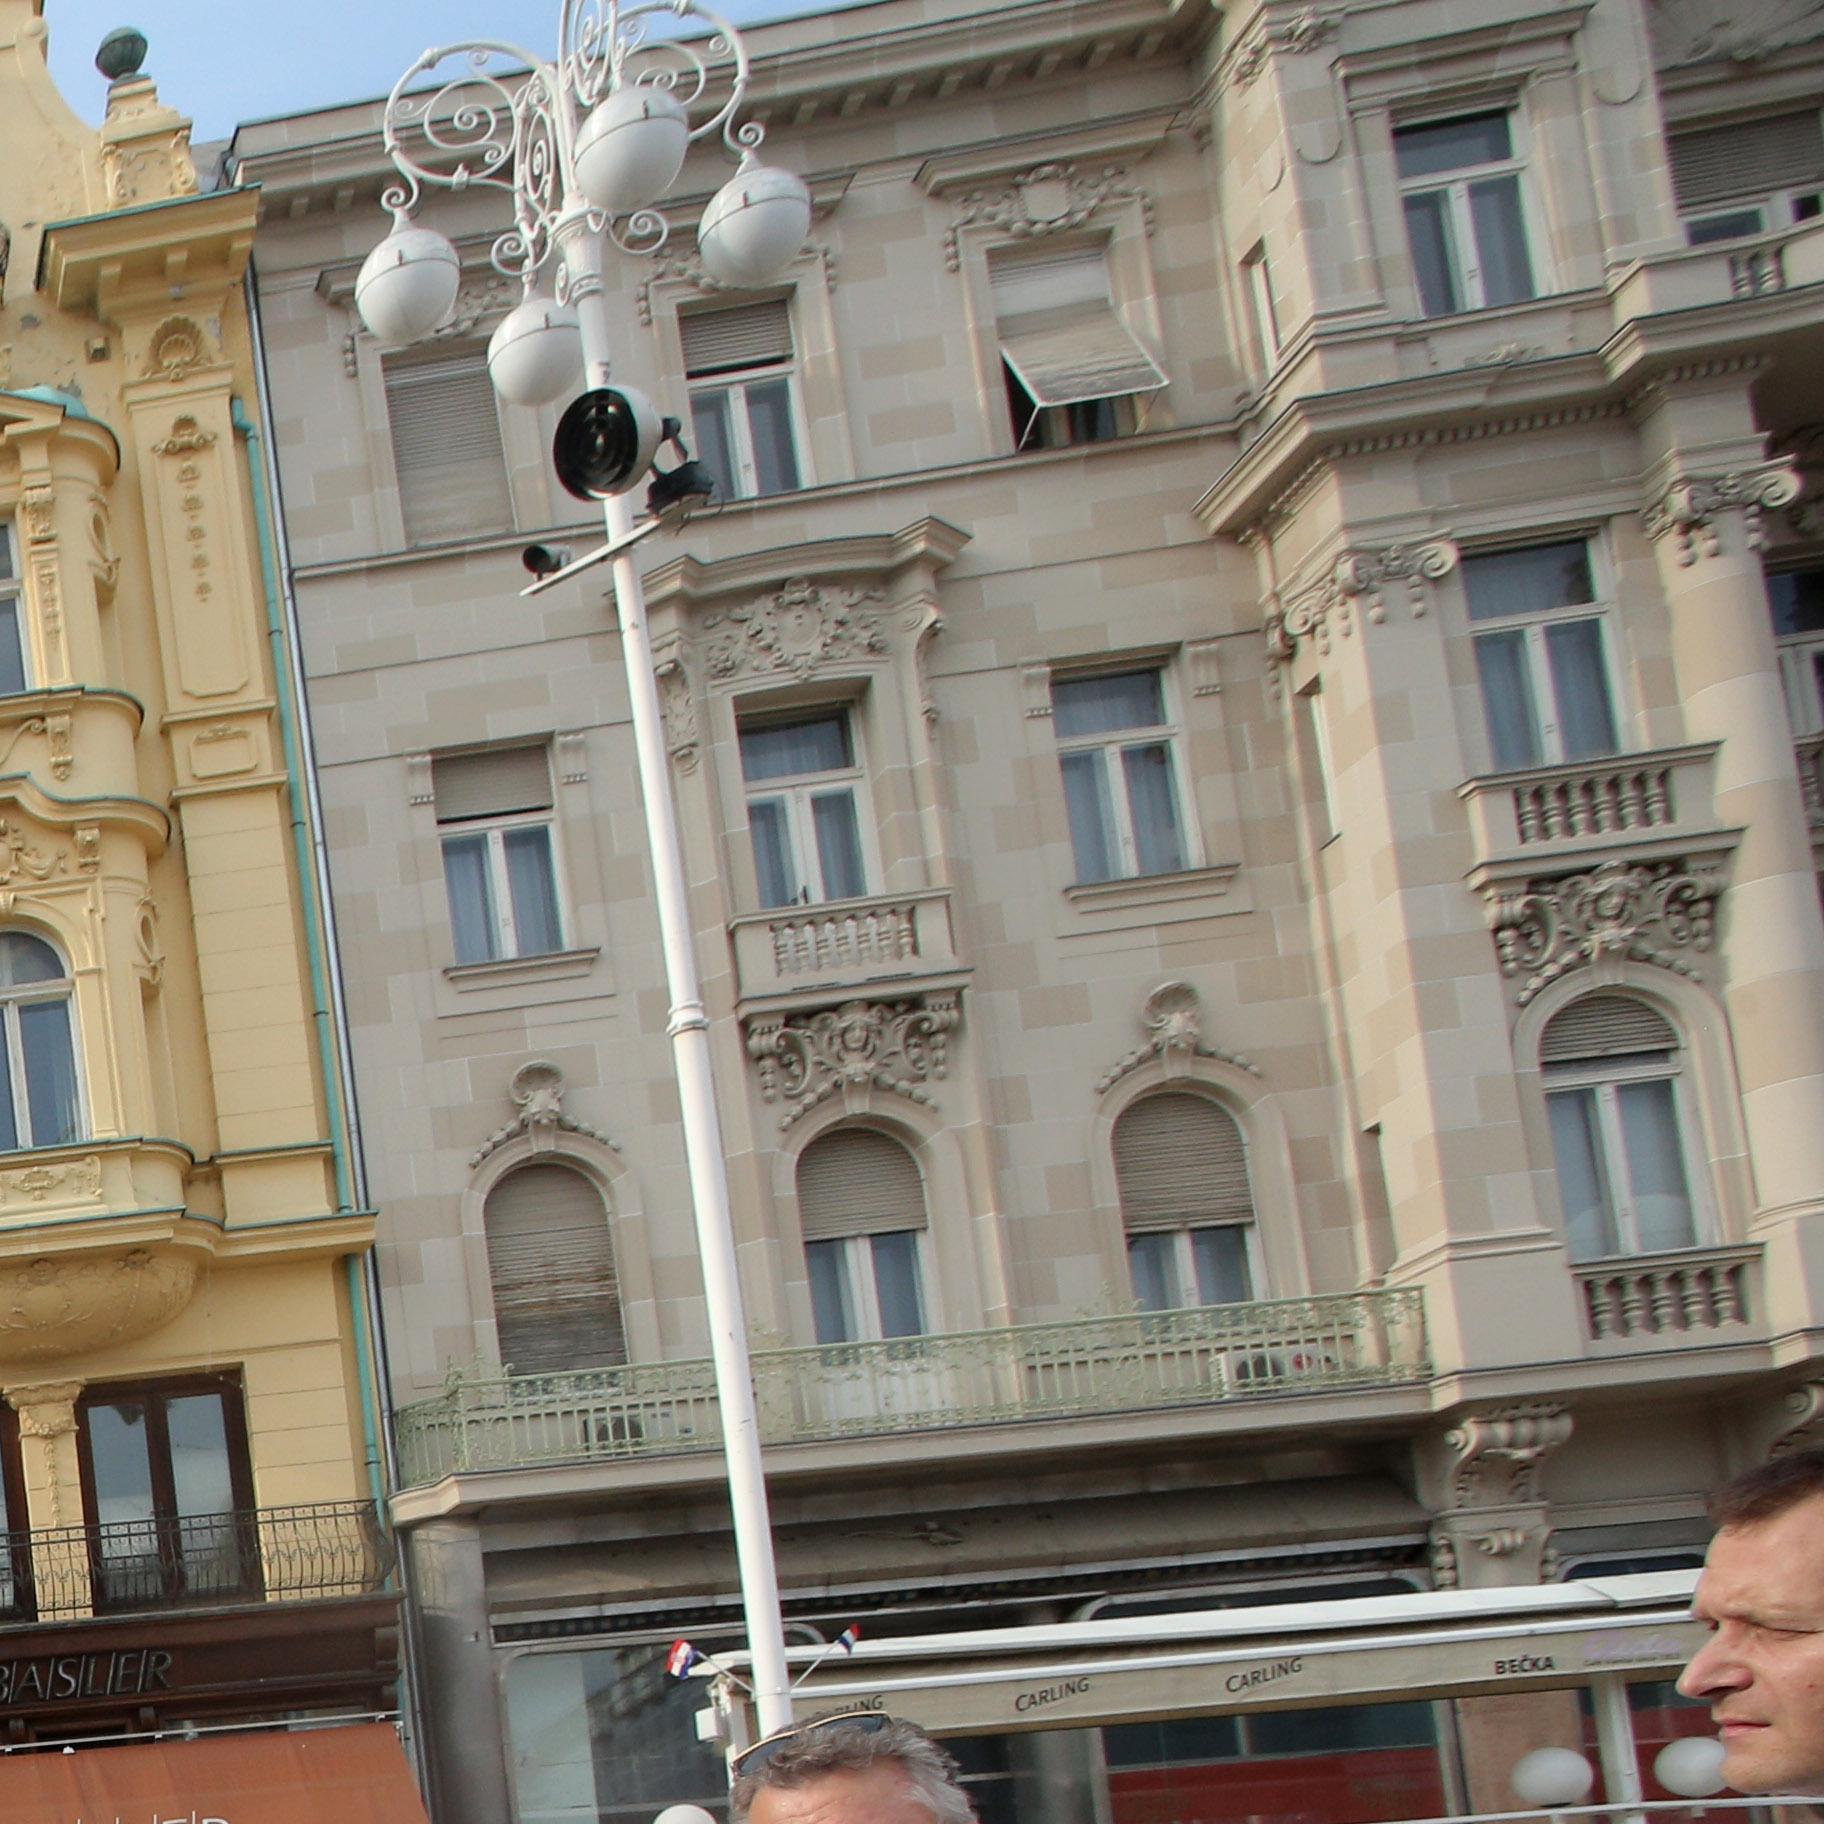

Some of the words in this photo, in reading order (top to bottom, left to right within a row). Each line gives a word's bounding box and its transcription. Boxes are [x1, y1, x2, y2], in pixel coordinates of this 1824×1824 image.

[1225, 1657, 1304, 1693] CARLING
[1495, 1654, 1555, 1676] BEČKA
[1015, 1677, 1090, 1712] CARLING
